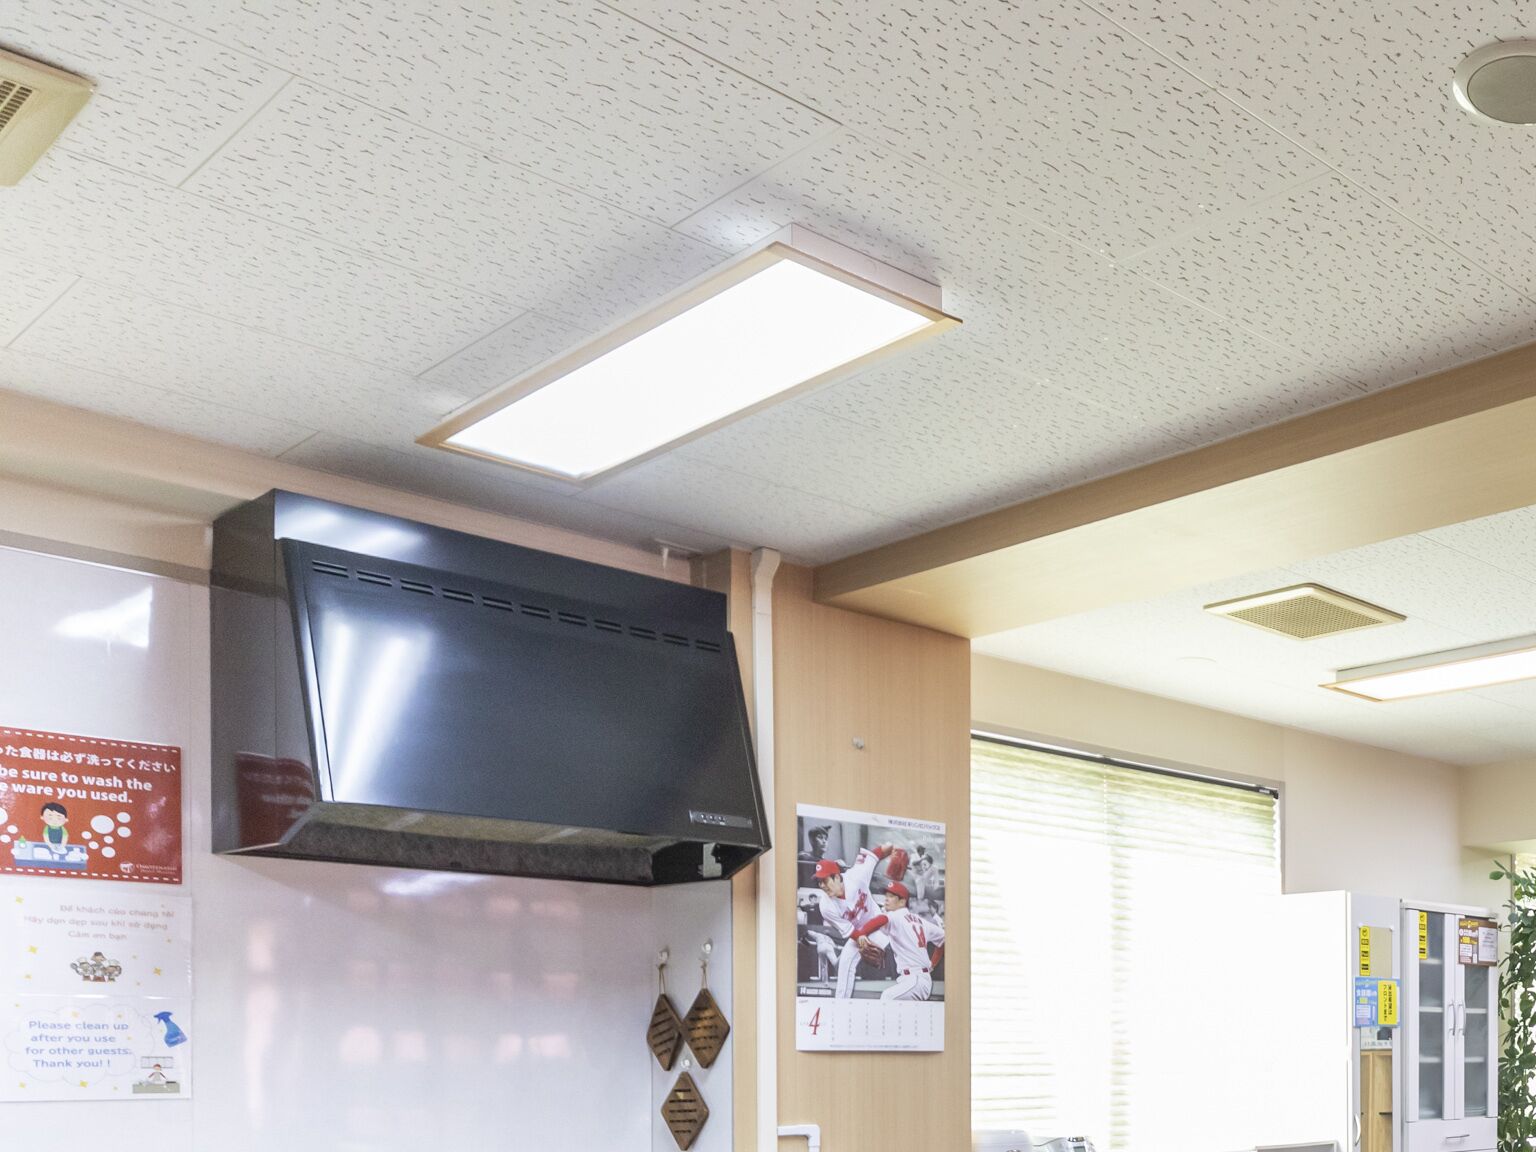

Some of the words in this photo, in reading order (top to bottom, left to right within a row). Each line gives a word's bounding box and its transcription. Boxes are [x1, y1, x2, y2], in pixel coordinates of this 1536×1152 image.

[22, 769, 58, 783] sure
[61, 771, 79, 785] to
[82, 774, 123, 789] wash
[127, 777, 153, 792] the
[12, 783, 54, 796] ware
[57, 787, 87, 800] you
[91, 789, 133, 804] used.
[29, 1020, 71, 1030] Please
[75, 1020, 109, 1030] clean
[113, 1022, 129, 1032] up
[808, 1006, 821, 1035] 4
[31, 1034, 65, 1043] after
[67, 1035, 90, 1045] you
[94, 1035, 116, 1043] use
[26, 1046, 45, 1055] for
[49, 1046, 84, 1055] other
[33, 1059, 72, 1068] Thank
